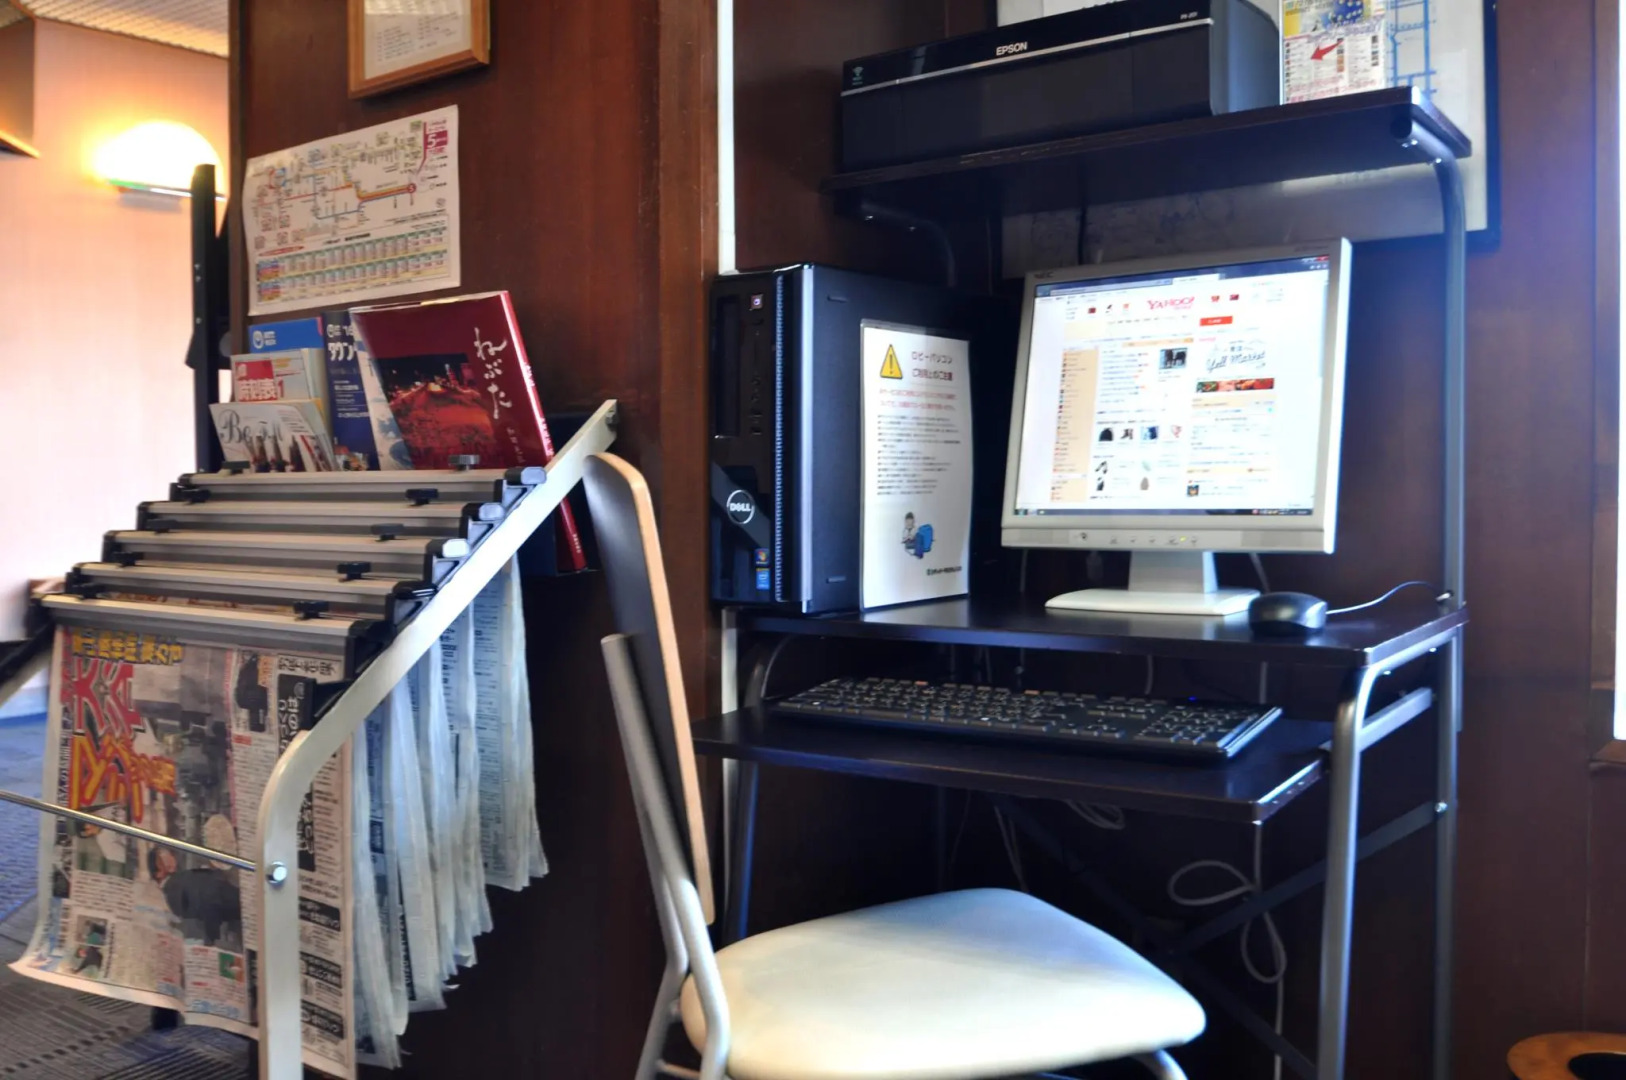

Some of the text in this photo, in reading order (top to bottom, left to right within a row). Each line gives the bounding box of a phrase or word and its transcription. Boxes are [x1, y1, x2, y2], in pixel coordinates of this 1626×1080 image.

[995, 41, 1028, 56] EPSON
[1147, 296, 1195, 310] YAHOO!
[473, 327, 513, 420] ねぶた
[729, 502, 752, 512] DELL
